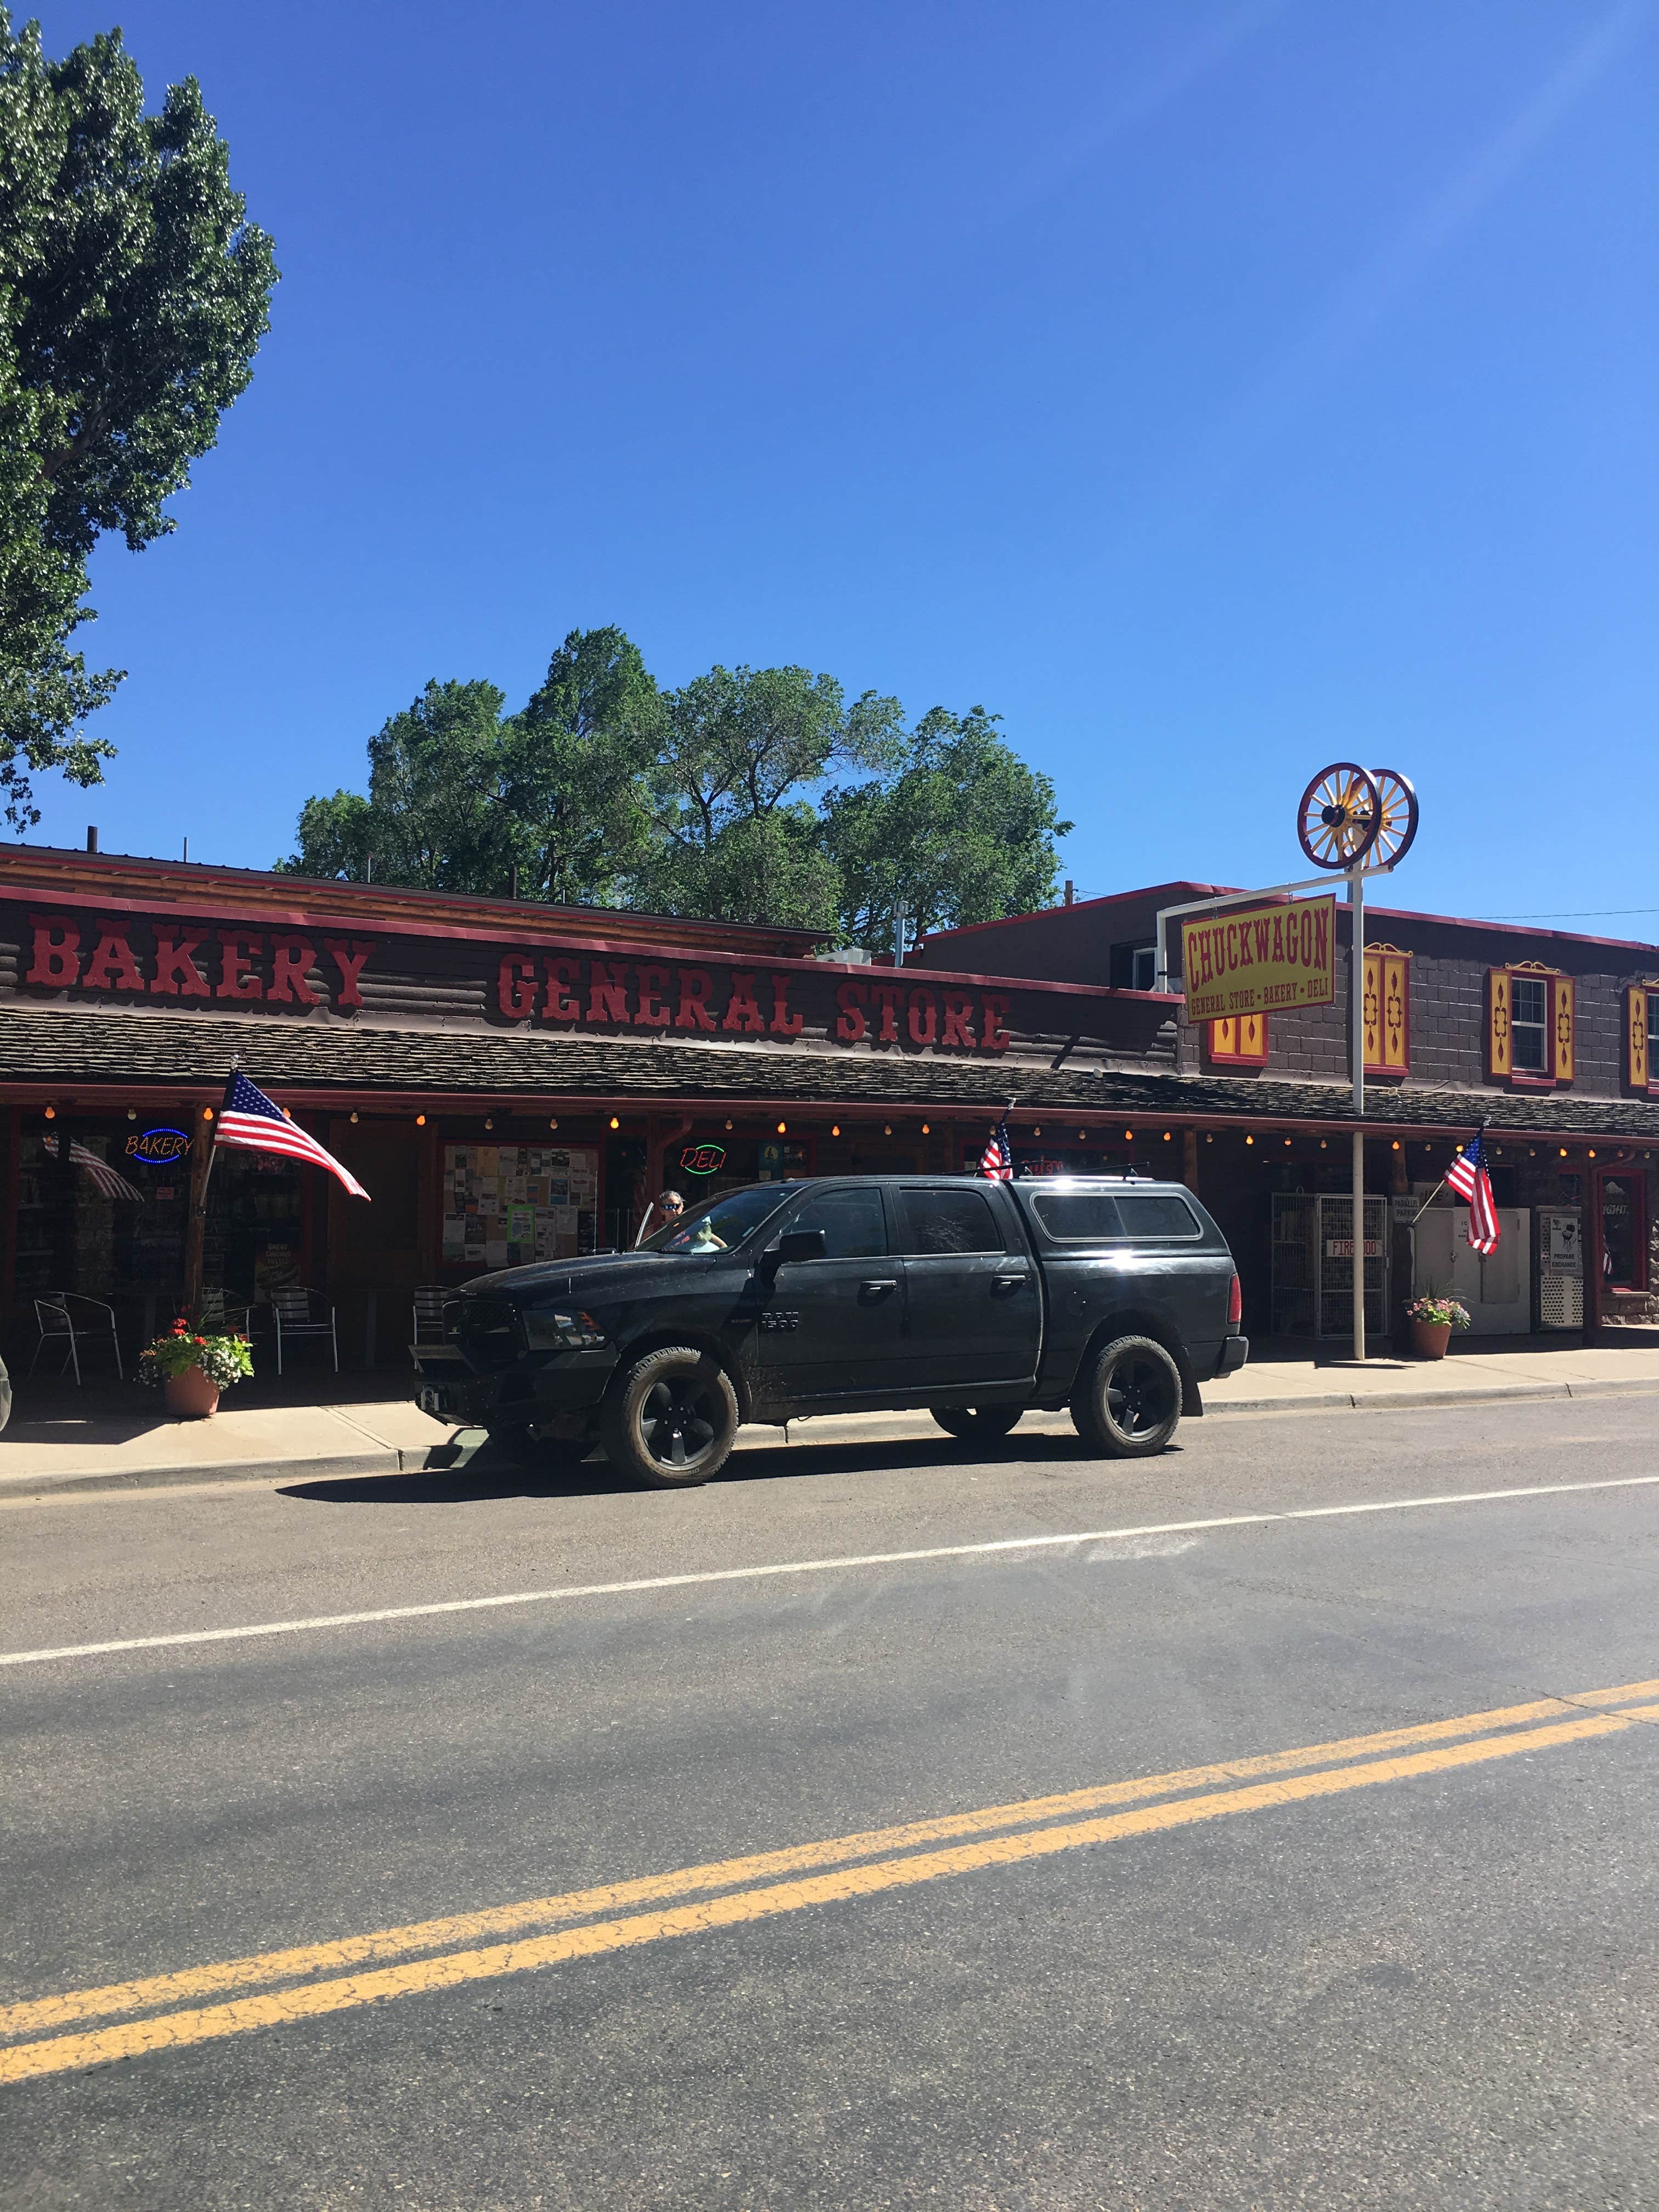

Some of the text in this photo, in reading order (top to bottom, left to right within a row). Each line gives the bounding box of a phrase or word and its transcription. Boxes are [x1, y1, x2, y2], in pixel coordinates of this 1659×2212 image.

[26, 913, 377, 1006] BAKERY
[1188, 906, 1329, 992] CHUCKWAGON
[498, 952, 1010, 1049] GENERAL STORE
[1191, 977, 1328, 1015] GENERAL STORE BAKERY DELI
[125, 1136, 195, 1155] BAKERY
[680, 1147, 727, 1168] DELI
[1395, 1199, 1418, 1207] PARALLEL
[1333, 1240, 1376, 1256] FIREOD
[761, 1312, 799, 1320] RAM
